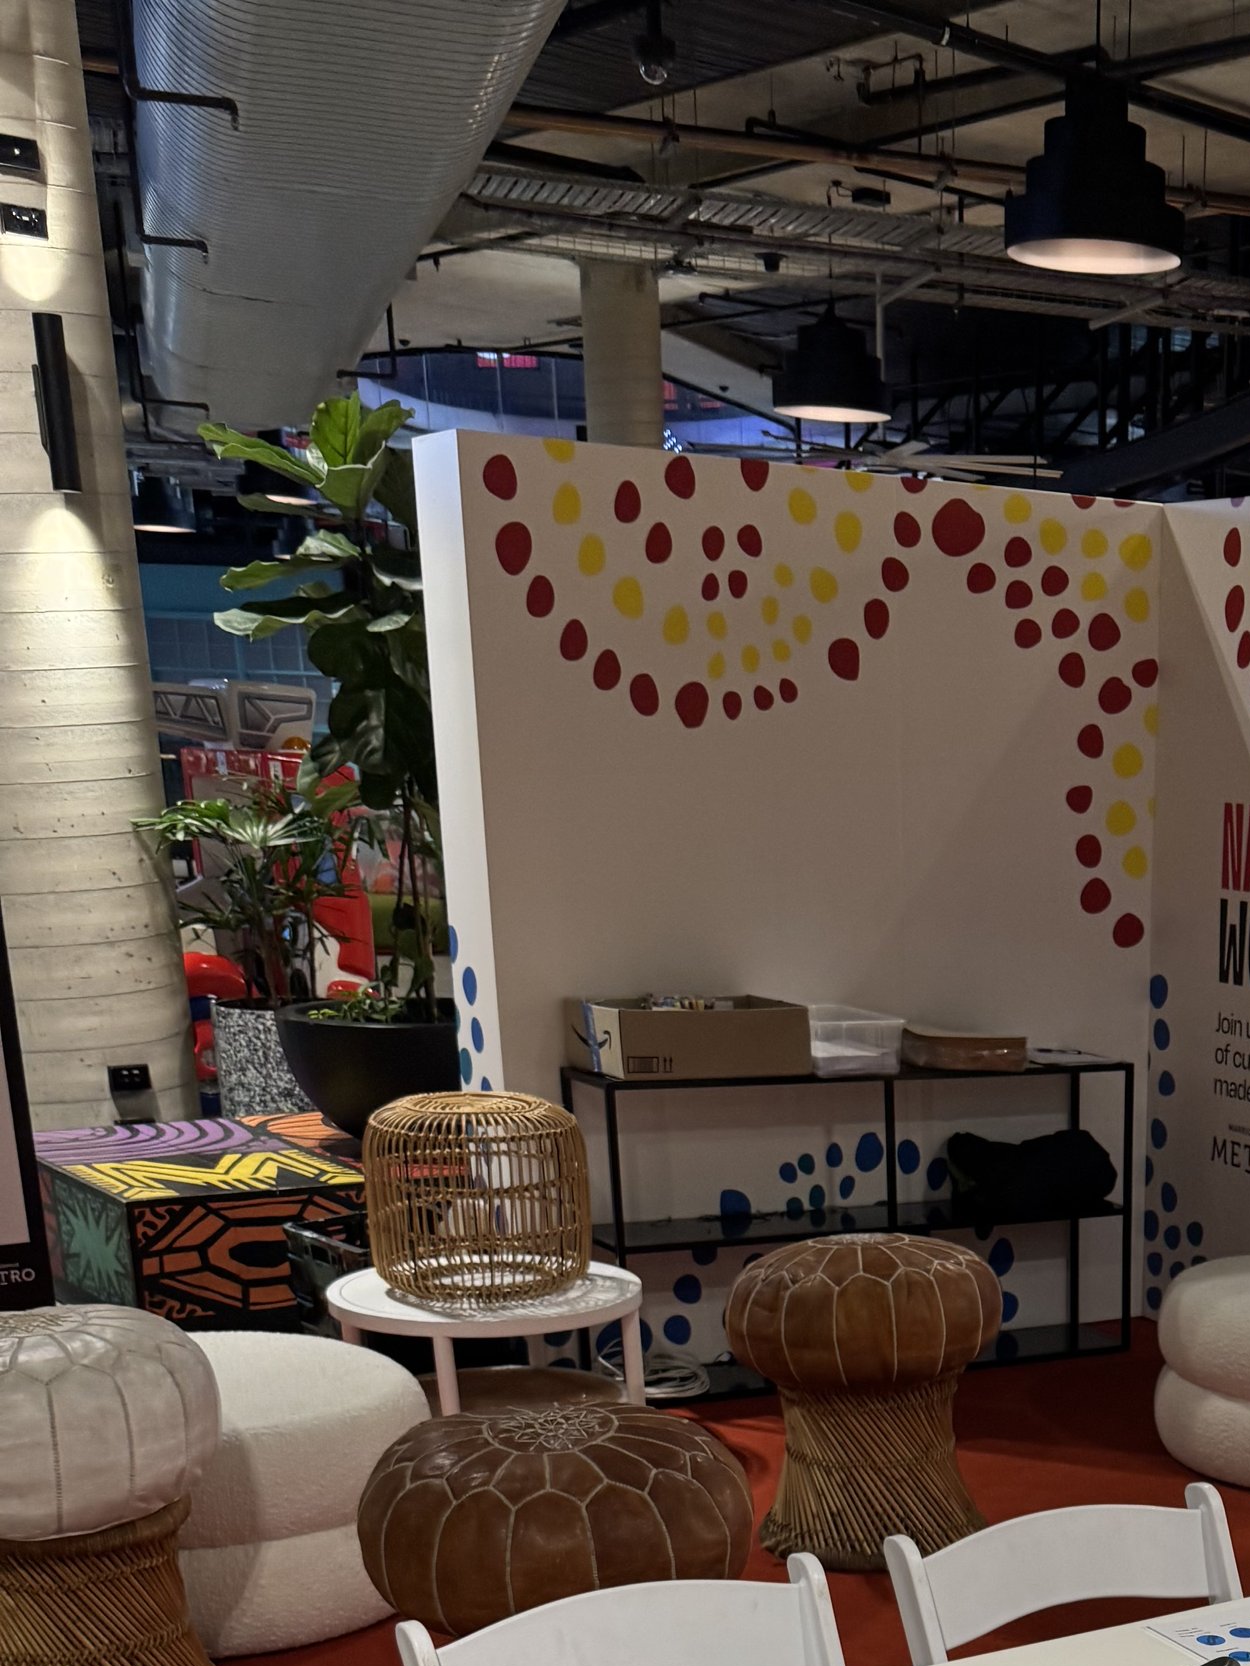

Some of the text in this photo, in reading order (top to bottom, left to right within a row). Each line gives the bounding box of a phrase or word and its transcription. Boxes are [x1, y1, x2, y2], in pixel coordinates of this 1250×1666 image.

[1215, 1011, 1243, 1037] Join
[1215, 1043, 1230, 1065] of
[0, 1268, 35, 1286] TRO
